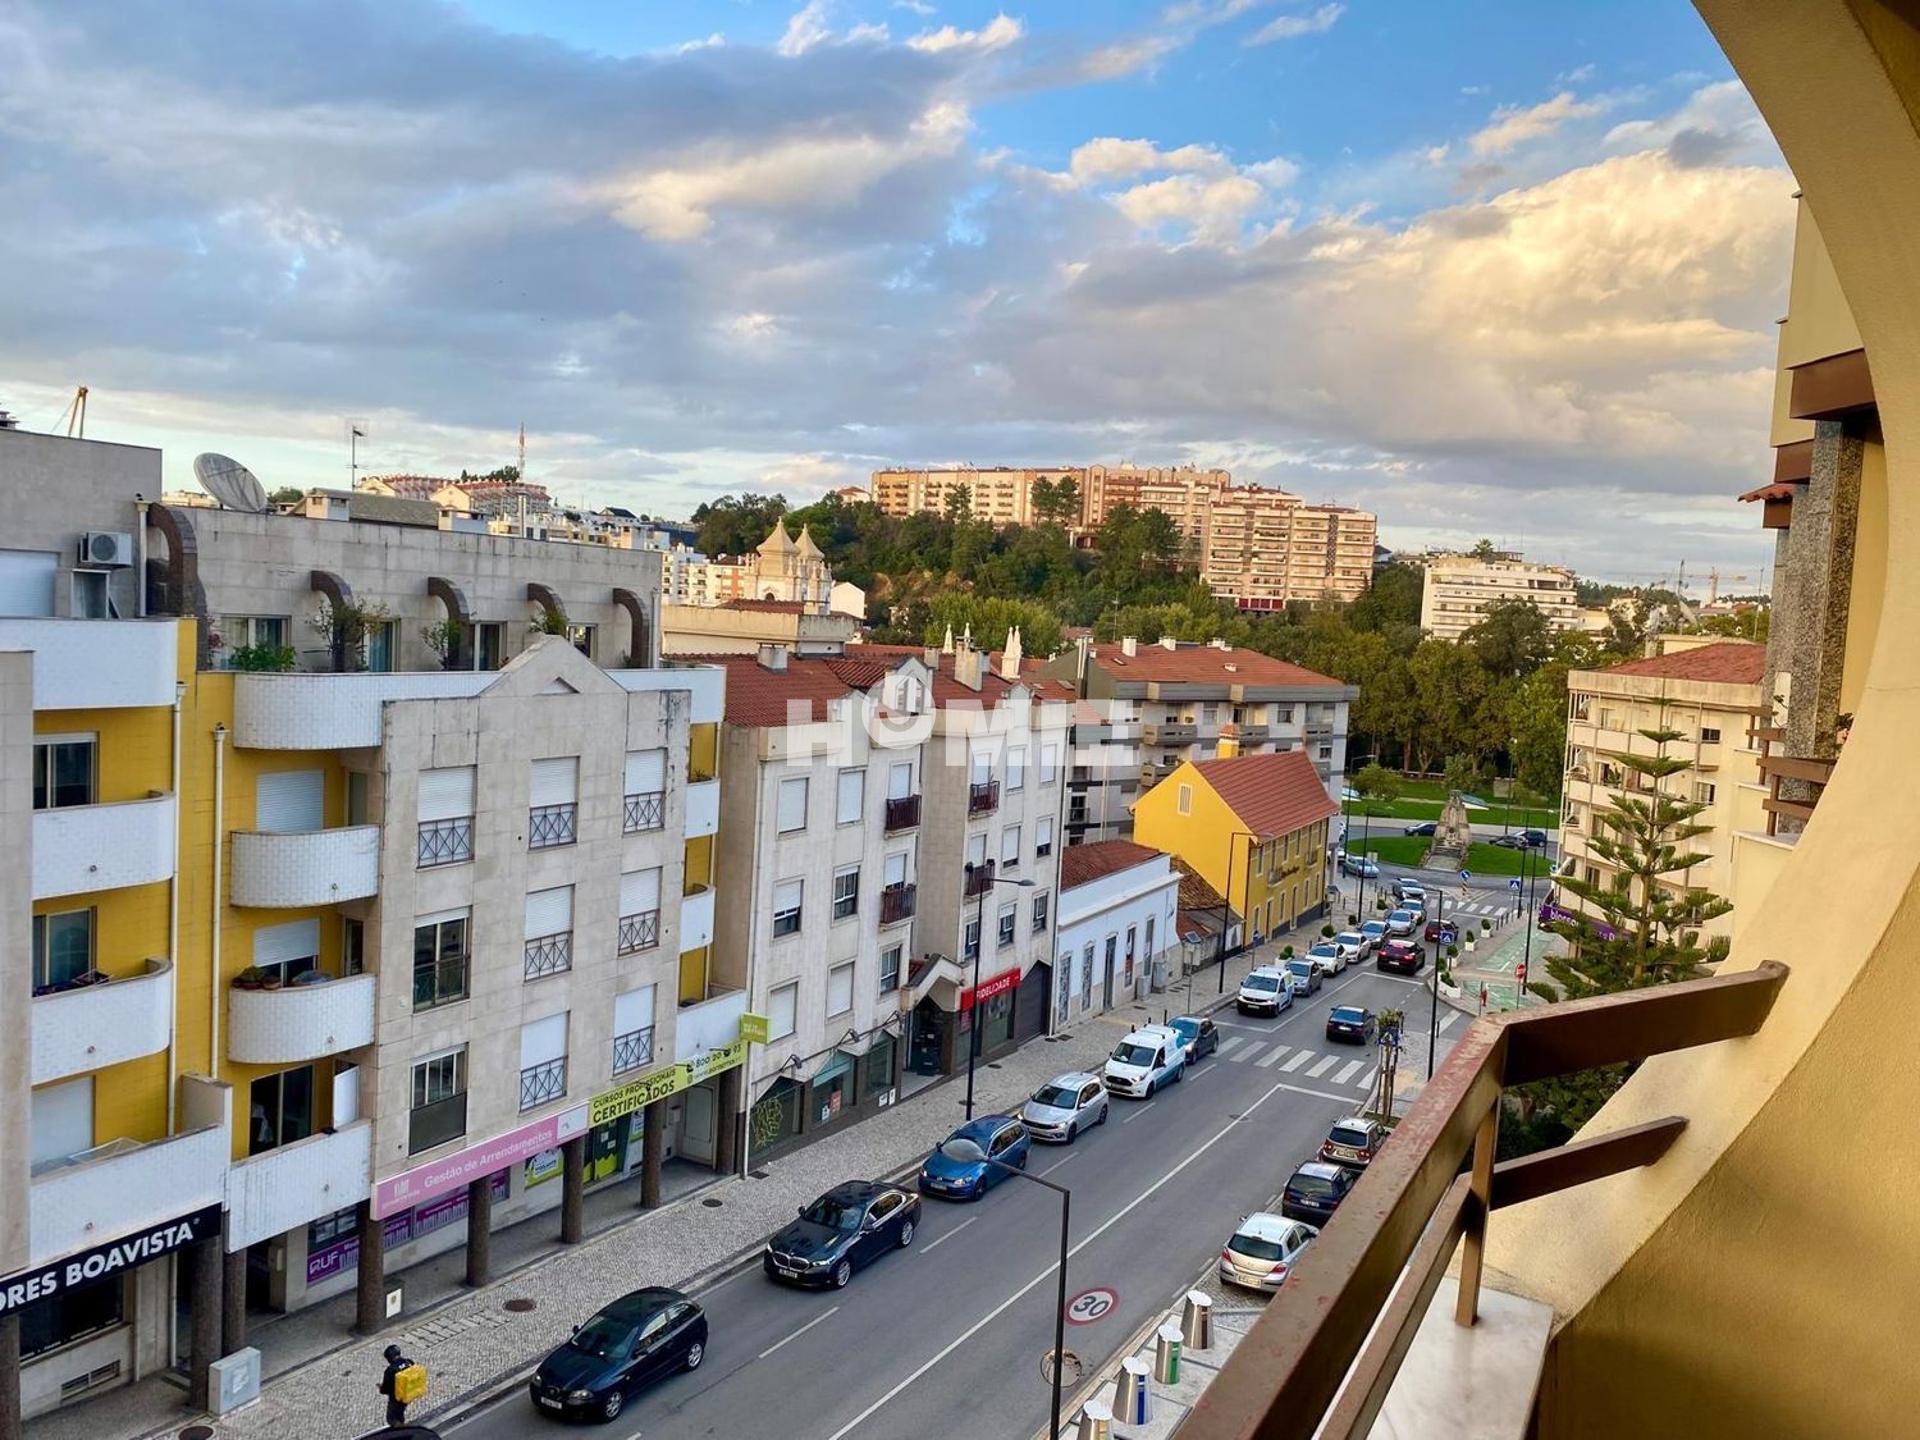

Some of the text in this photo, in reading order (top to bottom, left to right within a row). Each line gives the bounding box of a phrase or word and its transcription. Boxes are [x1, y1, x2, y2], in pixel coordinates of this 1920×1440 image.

[592, 1079, 675, 1123] CERTIFICADOS
[593, 1090, 624, 1109] CURSOS
[424, 1165, 462, 1188] Gestão
[464, 1159, 478, 1174] de
[479, 1130, 553, 1166] Arrendamentos
[66, 1222, 193, 1287] BOAVISTA
[1073, 1295, 1109, 1317] 30
